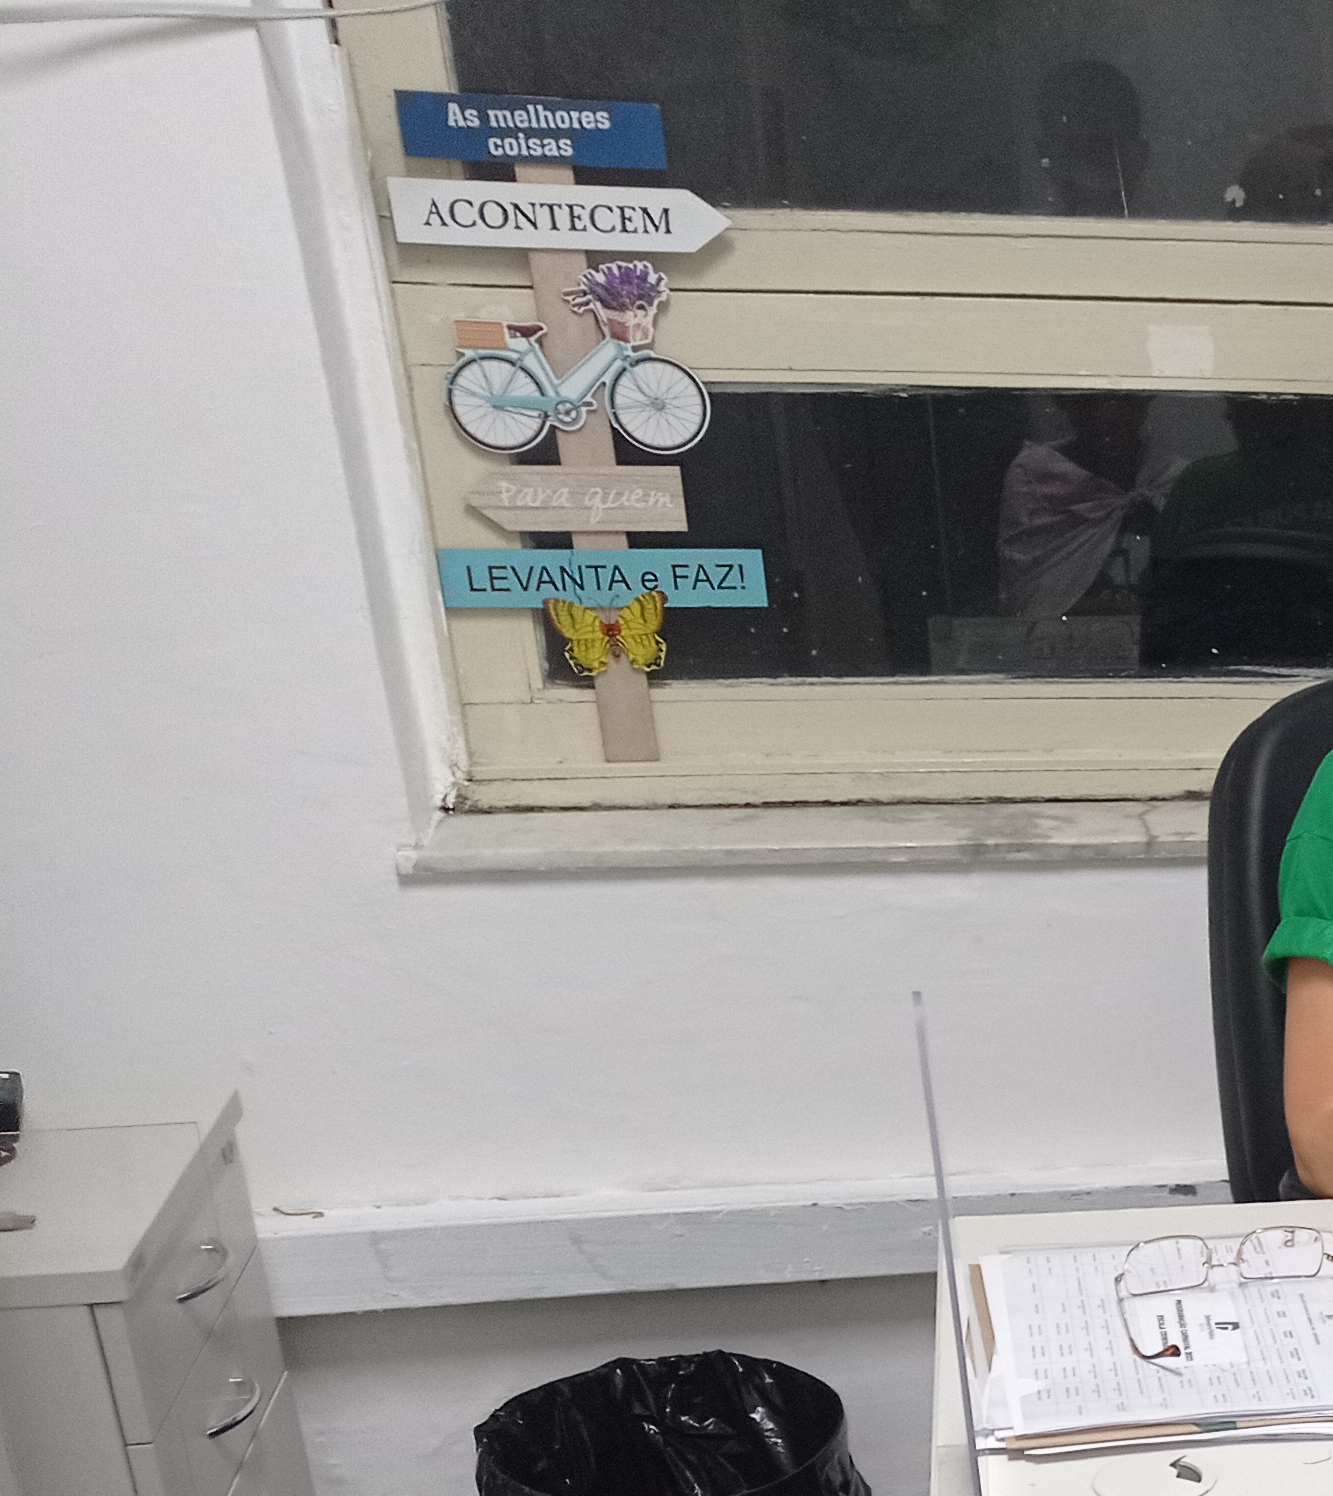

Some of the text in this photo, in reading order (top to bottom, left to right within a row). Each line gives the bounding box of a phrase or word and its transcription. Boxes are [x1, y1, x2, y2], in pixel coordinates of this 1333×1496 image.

[447, 102, 611, 130] As melhores
[487, 132, 574, 157] coisas
[422, 197, 673, 235] ACONTECEM
[498, 481, 674, 523] Para quem
[466, 563, 746, 593] LEVANTA e FAZ!
